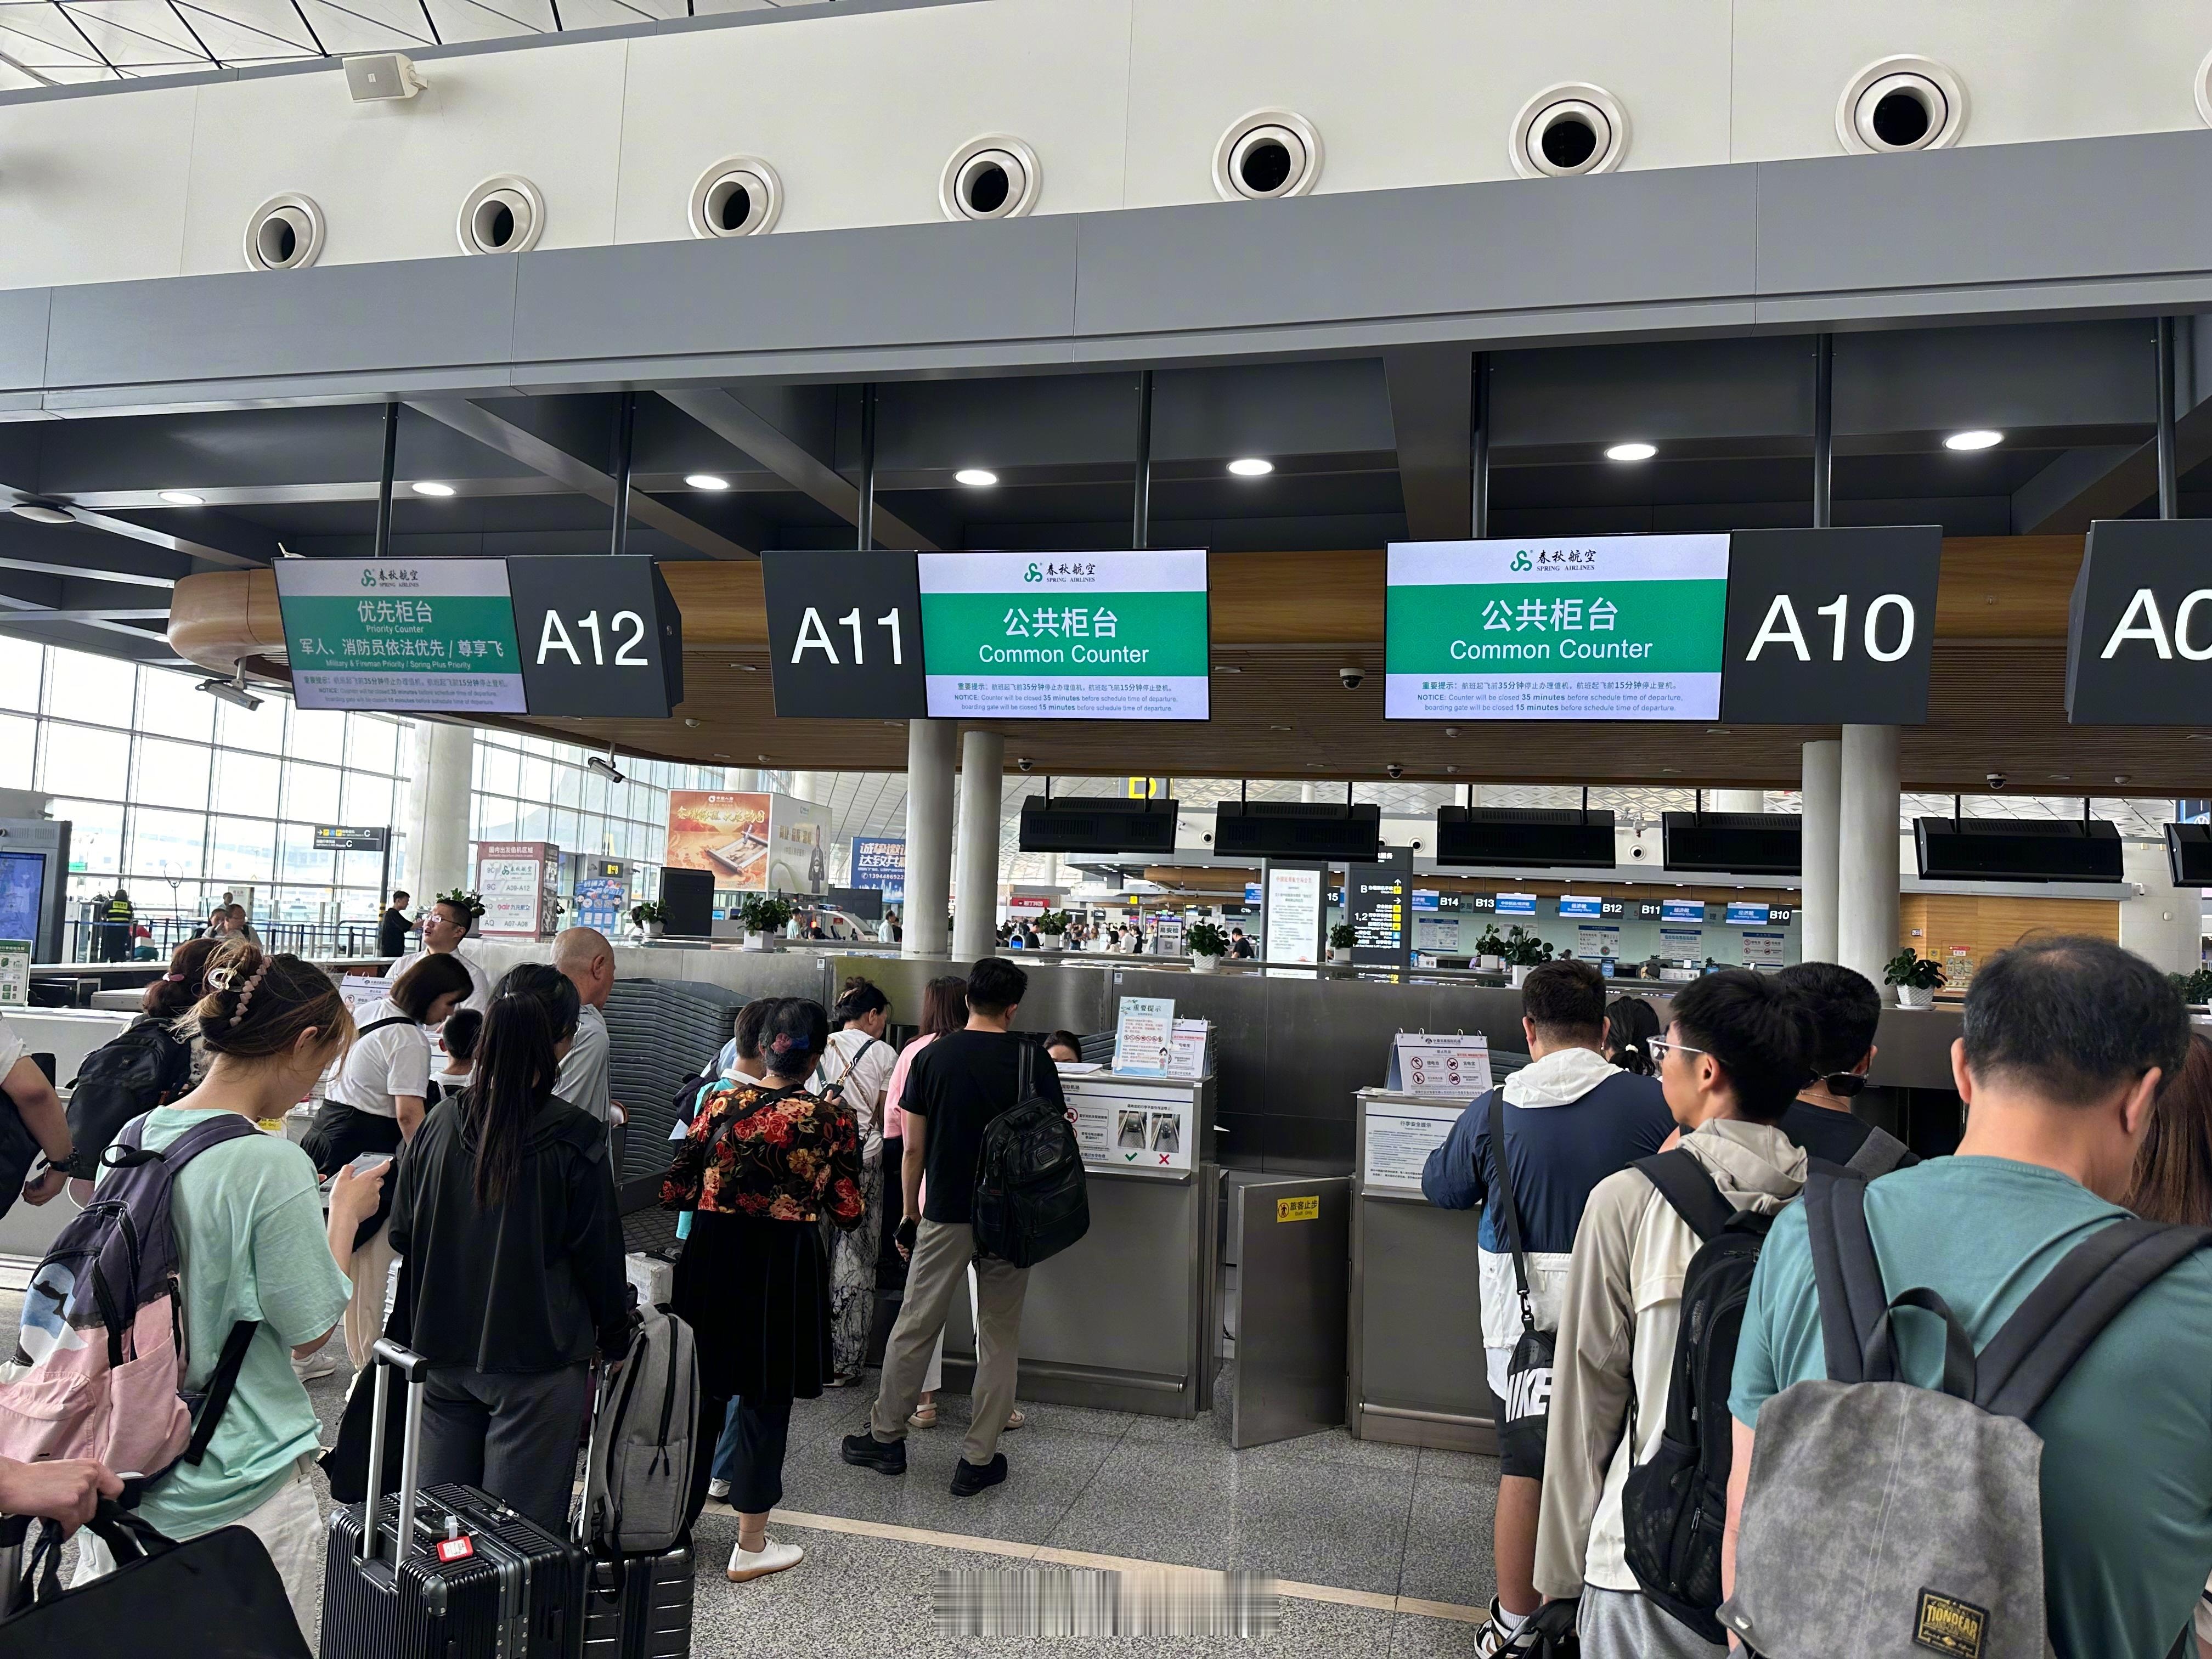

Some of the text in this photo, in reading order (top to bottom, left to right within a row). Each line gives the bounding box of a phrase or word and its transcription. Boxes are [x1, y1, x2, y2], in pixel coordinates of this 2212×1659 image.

[1537, 549, 1597, 563] 春秋航空
[379, 568, 418, 580] 春秋航空
[1046, 563, 1096, 575] 春秋航空
[358, 600, 432, 623] 优先柜台
[1482, 597, 1618, 631] 公共柜台
[1003, 607, 1118, 638] 公共柜台
[1745, 594, 1914, 662] A10
[366, 625, 393, 634] Priority
[791, 607, 902, 664] A11
[536, 610, 648, 666] A12
[299, 638, 444, 658] 军人、消防员依法优先
[458, 640, 504, 658] 尊享飞
[979, 645, 1149, 663] Common Counter
[1451, 639, 1654, 659] Common Counter
[382, 661, 405, 669] Priority
[411, 661, 431, 669] Spring
[448, 662, 471, 670] Priority
[1361, 885, 1368, 893] B
[1440, 898, 1459, 906] B14
[1475, 899, 1494, 907] B13
[1602, 904, 1622, 913] B12
[1641, 905, 1661, 915] B11
[1769, 910, 1790, 920] B10
[1133, 1004, 1161, 1012] 重要提示
[1290, 1200, 1318, 1211] 旅客止步
[1505, 1368, 1554, 1423] NIKE
